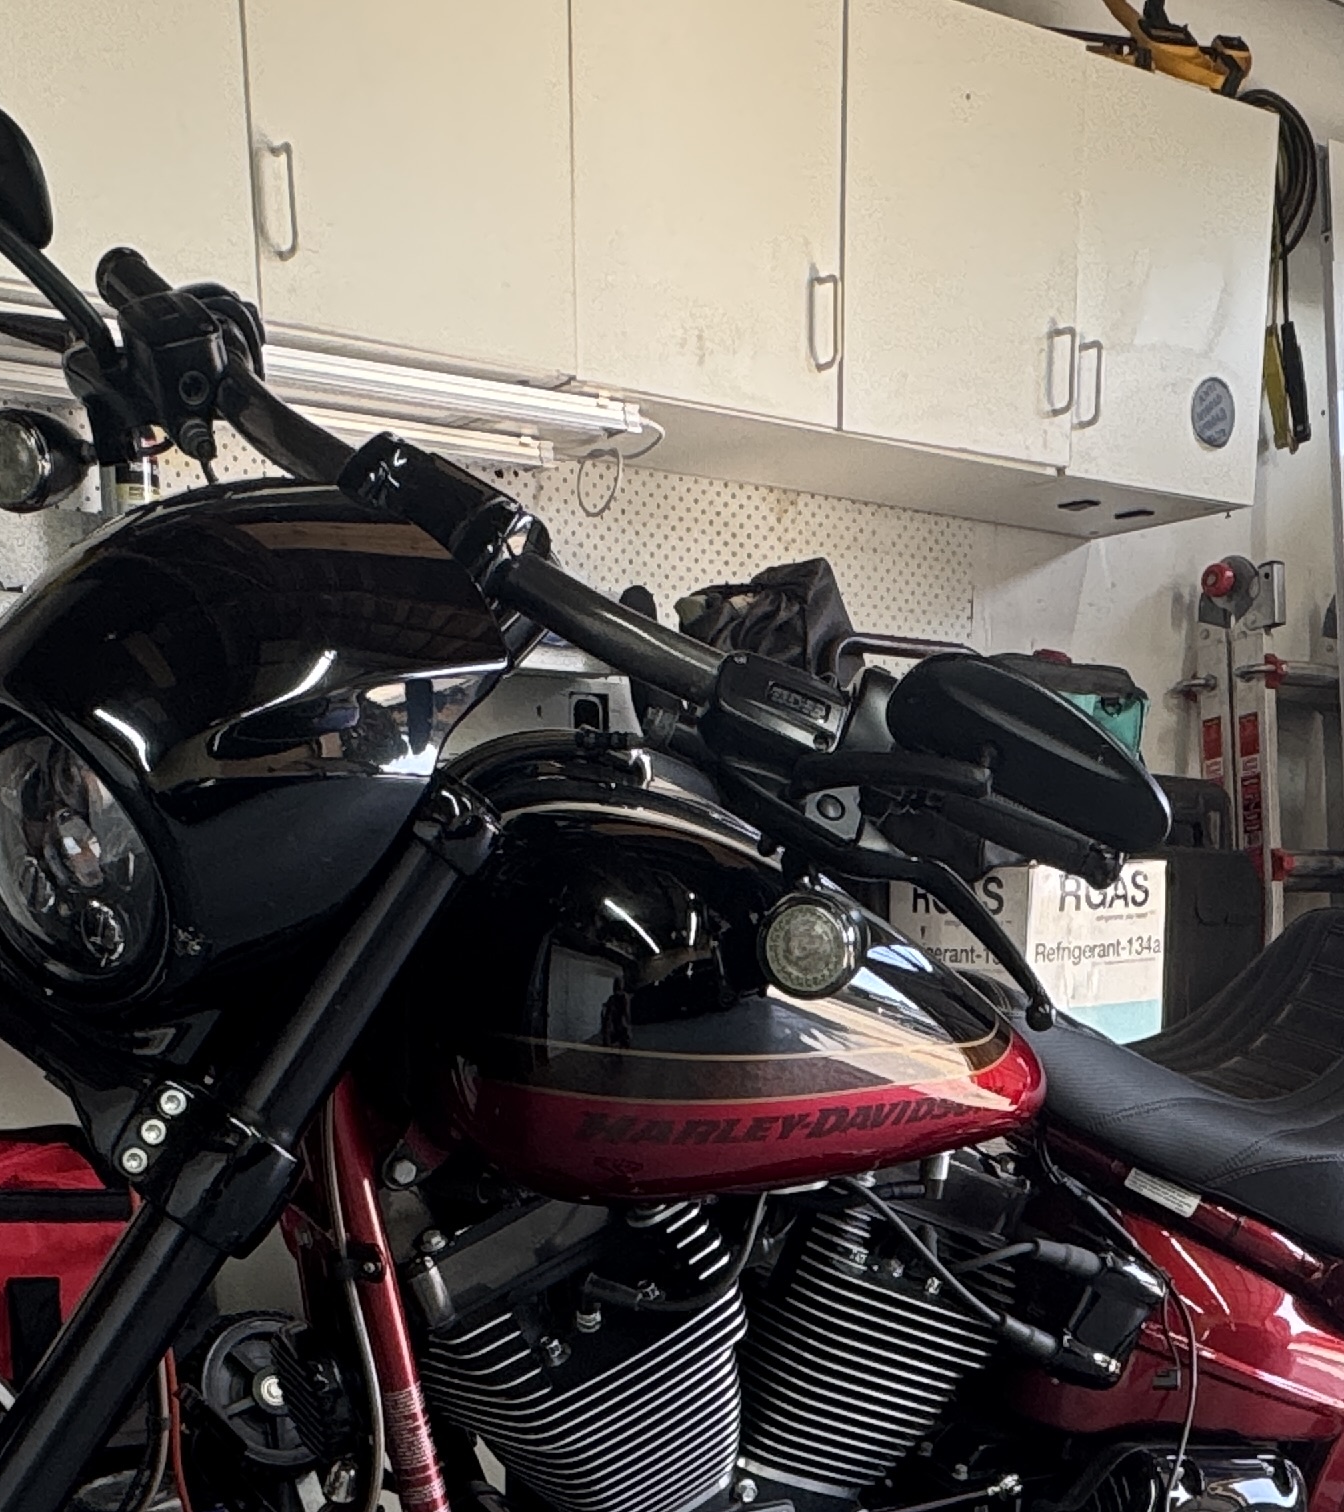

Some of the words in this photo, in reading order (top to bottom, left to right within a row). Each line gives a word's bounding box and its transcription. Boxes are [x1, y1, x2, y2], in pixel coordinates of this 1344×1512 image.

[912, 876, 1005, 915] RS
[1058, 868, 1150, 912] RGAS
[1035, 935, 1162, 966] Refrigerant-134a
[575, 1097, 980, 1144] HARLEY-DAVIDSO
